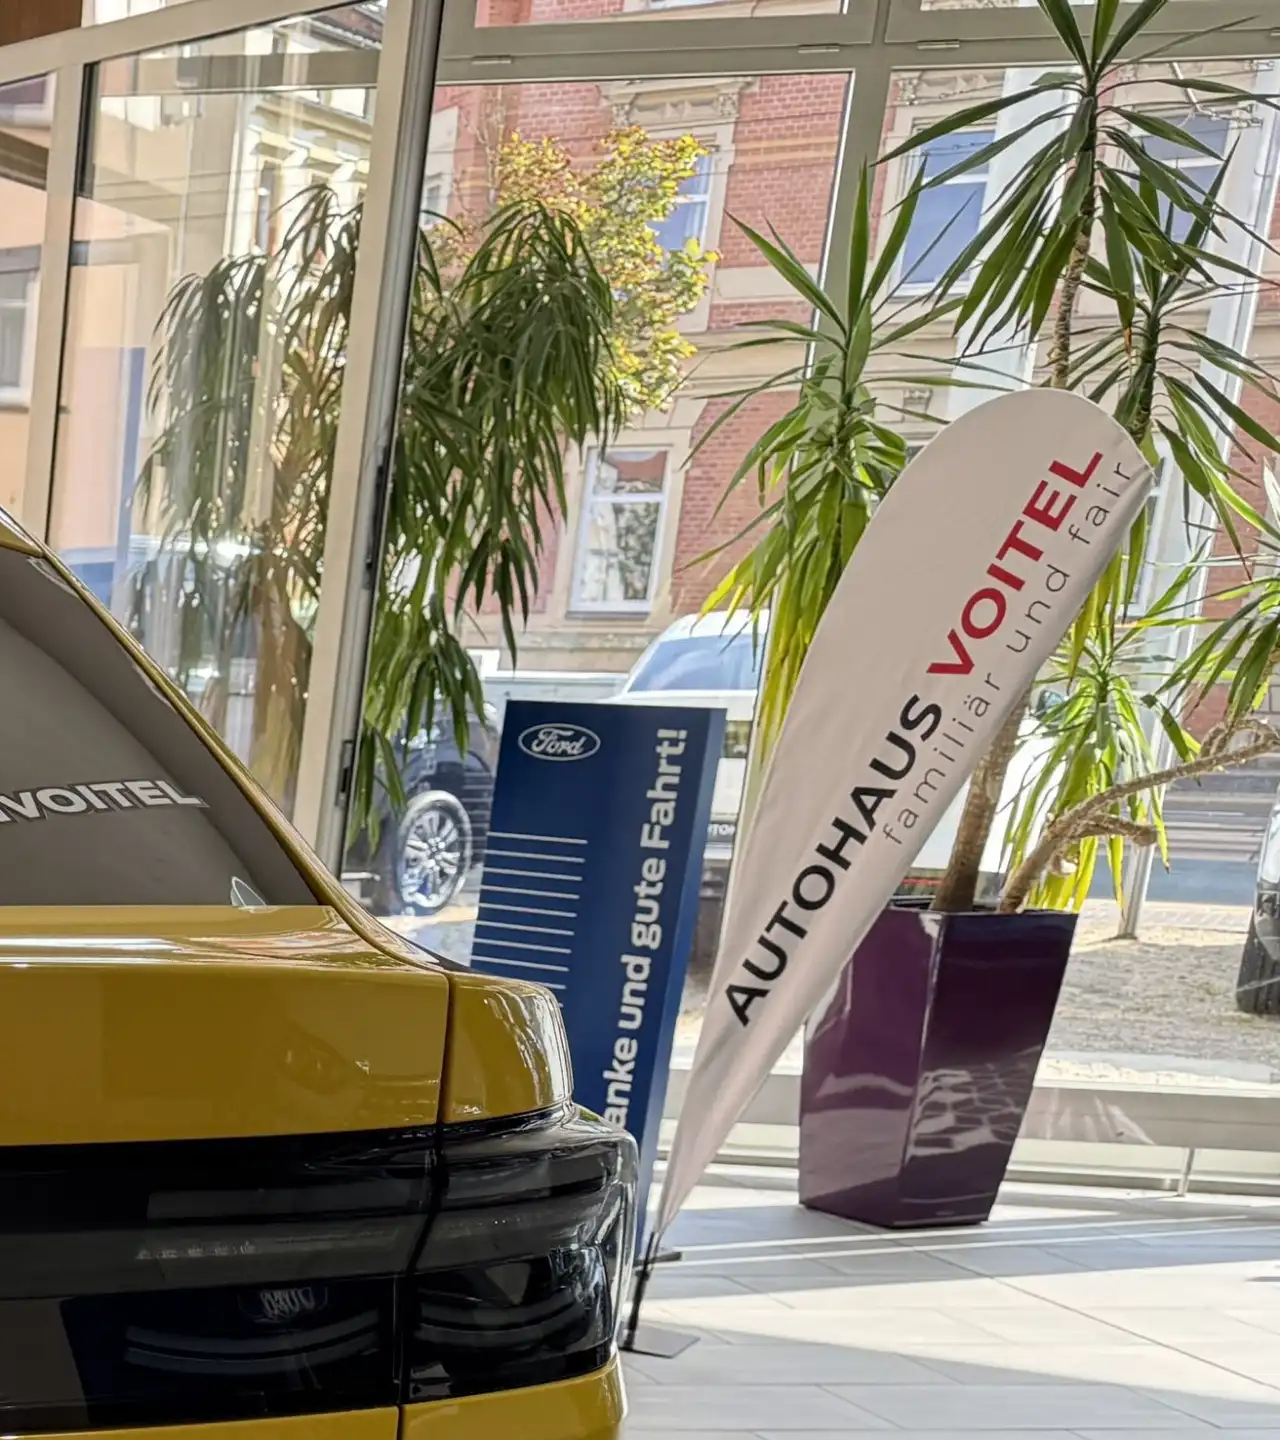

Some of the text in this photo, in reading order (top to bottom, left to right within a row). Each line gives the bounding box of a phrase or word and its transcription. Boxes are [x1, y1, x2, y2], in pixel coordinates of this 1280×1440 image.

[531, 727, 587, 756] Ford
[723, 450, 1104, 1028] AUTOHAUS VOITEL
[879, 458, 1130, 847] familiär und fair
[602, 728, 688, 1130] anke und gute Fahrt!
